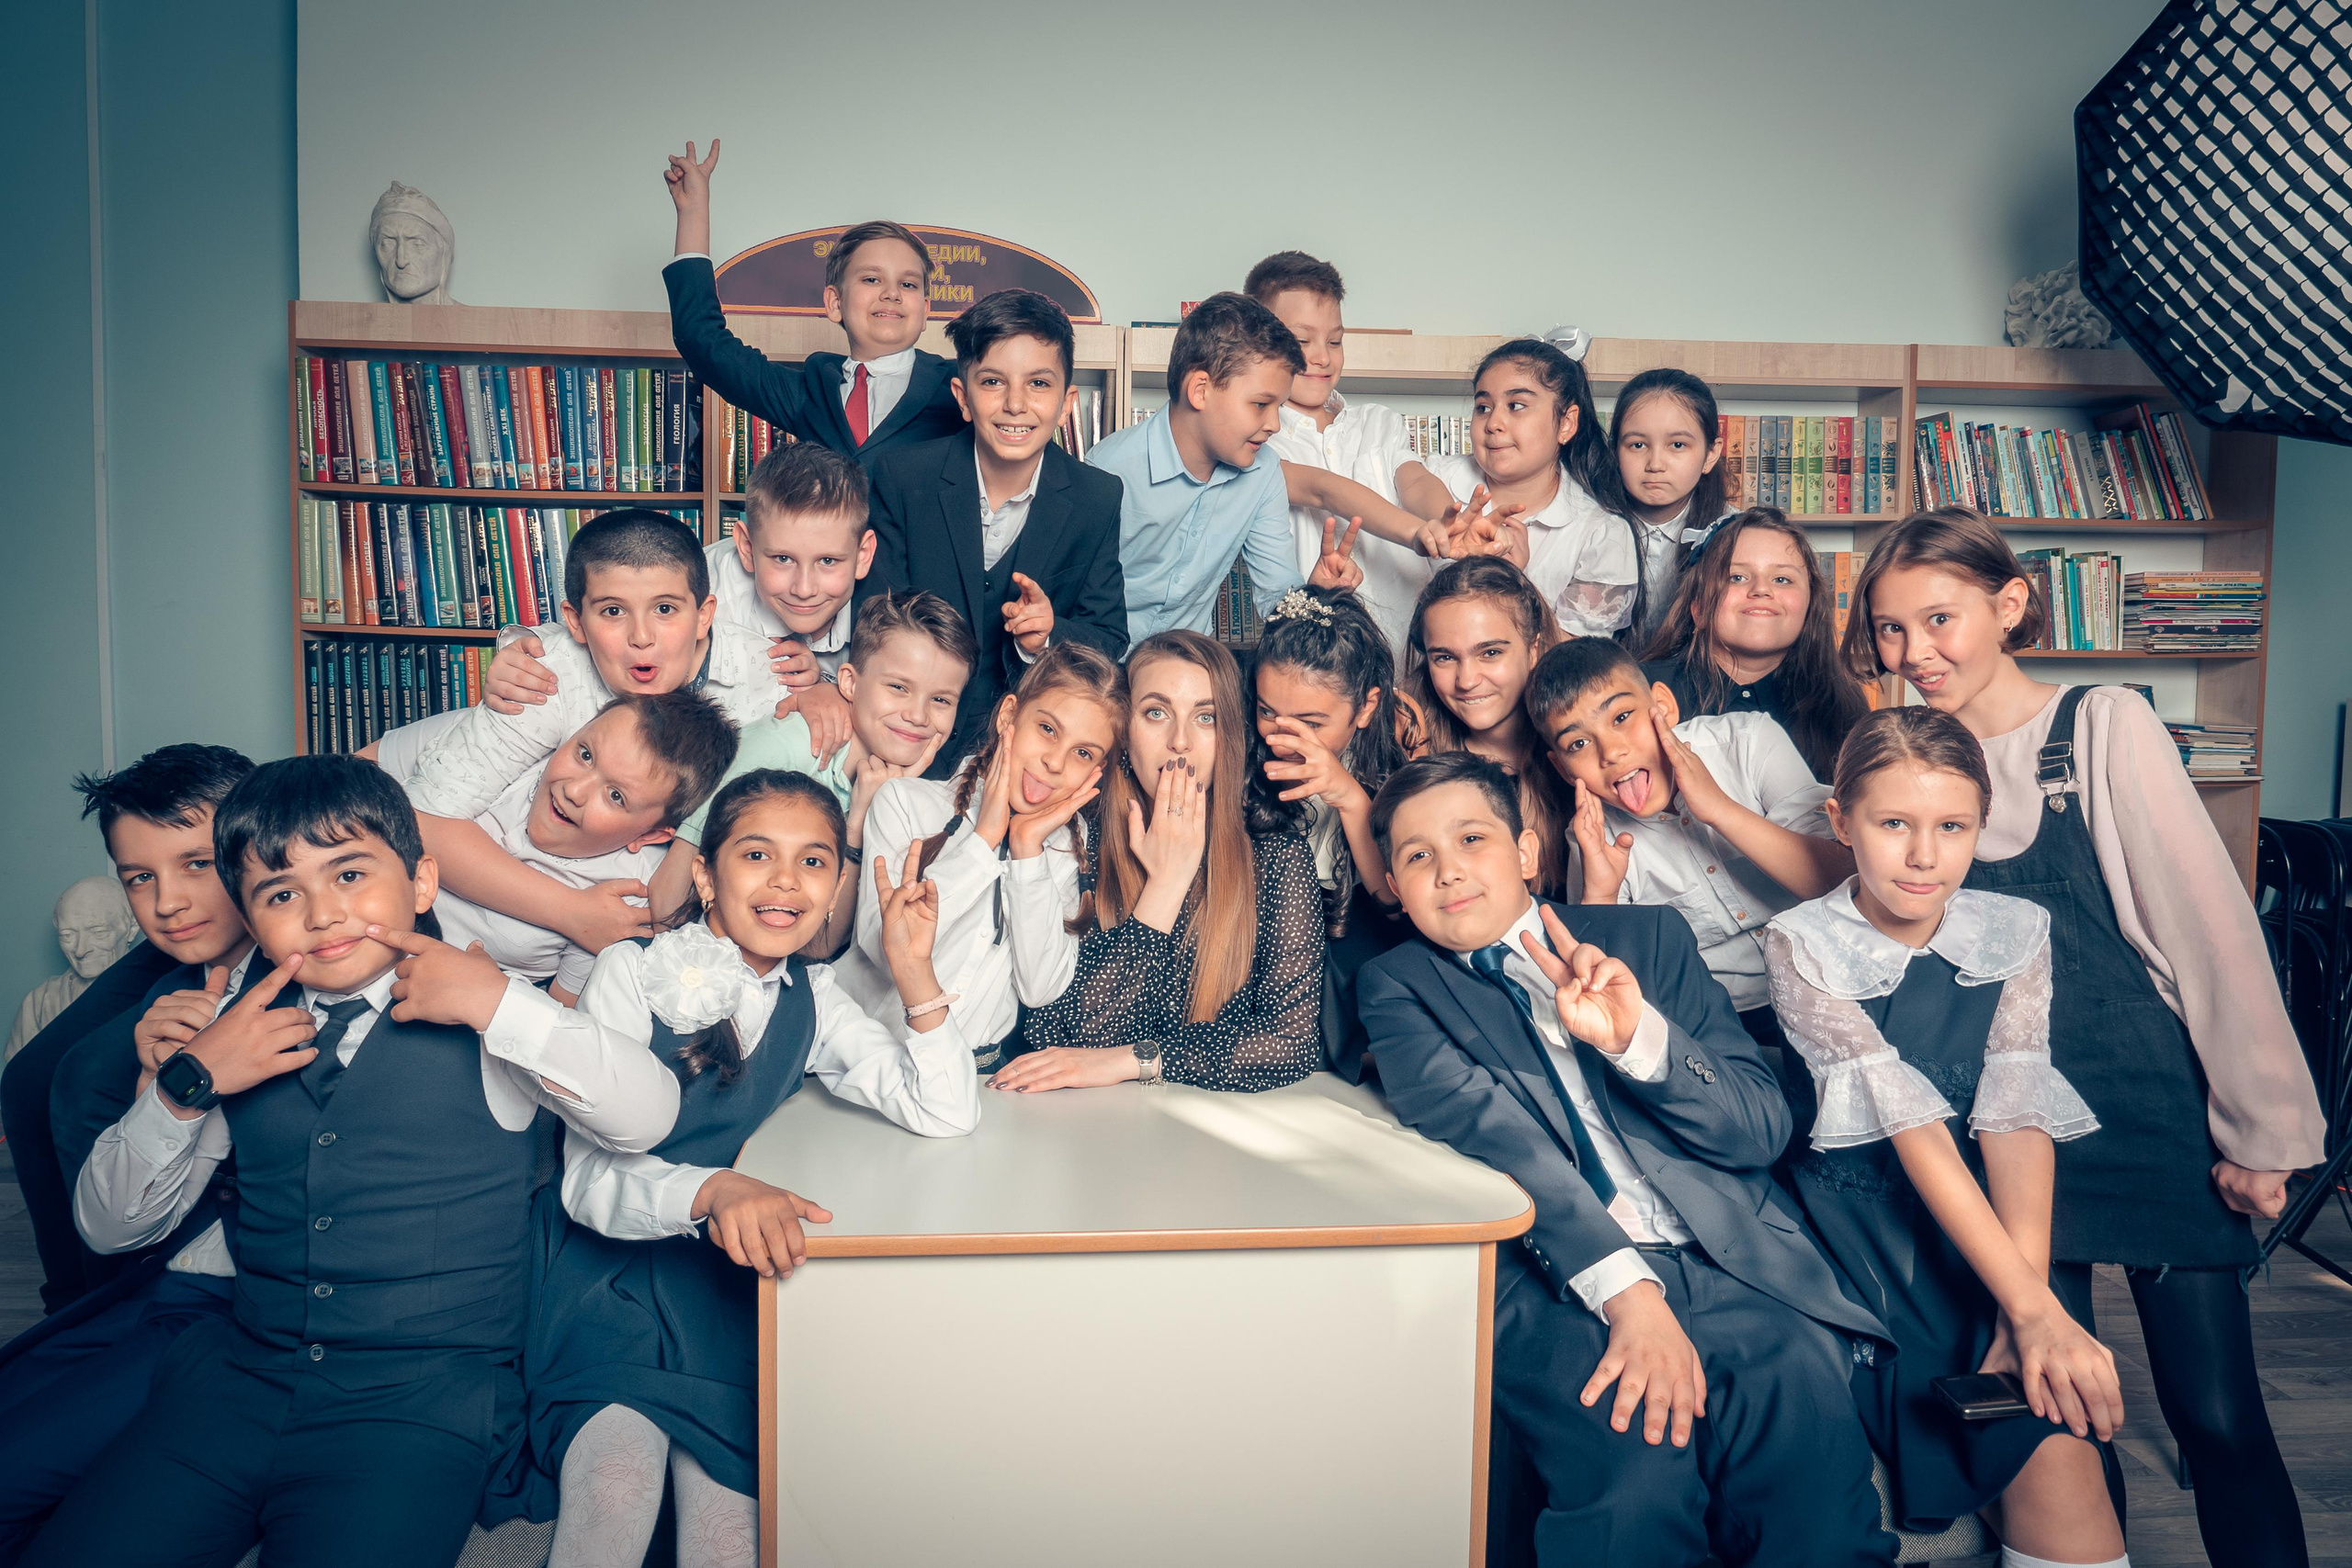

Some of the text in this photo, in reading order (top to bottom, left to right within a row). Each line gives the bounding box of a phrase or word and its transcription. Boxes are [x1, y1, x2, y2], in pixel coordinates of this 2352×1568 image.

[428, 385, 437, 411] СТРАНЫ
[433, 412, 444, 456] ЗАРУБЕЖНЫЕ
[396, 510, 405, 535] ДЕТЕЙ
[364, 540, 372, 576] ЧЕЛОВЕК
[488, 517, 507, 623] ЭНЦИКЛОПЕДИЯ ДЛЯ ДЕТЕЙ
[401, 556, 414, 619] ЭНЦИКЛОПЕДИЯ
[537, 563, 545, 592] КОМПЬЮТЕР
